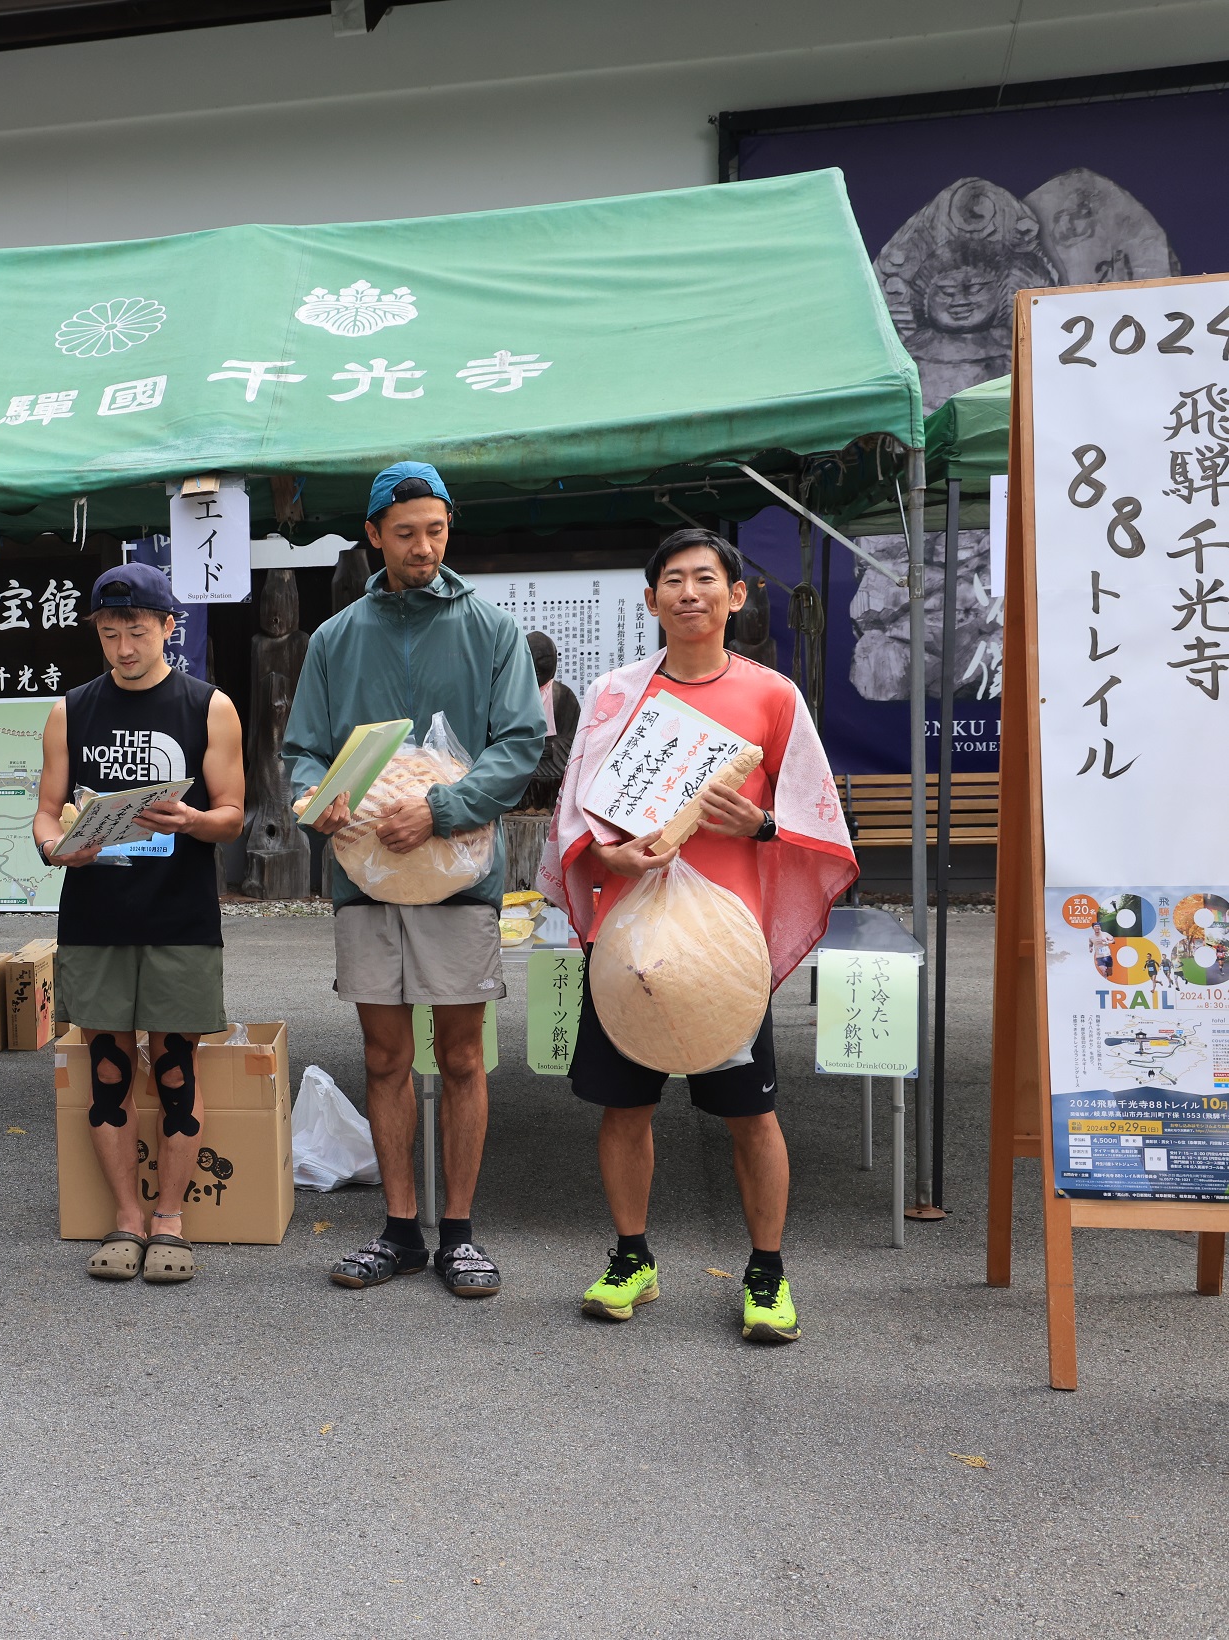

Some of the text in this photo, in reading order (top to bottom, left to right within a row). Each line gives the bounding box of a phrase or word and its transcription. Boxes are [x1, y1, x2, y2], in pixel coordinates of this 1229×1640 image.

[207, 349, 554, 402] 千光寺
[195, 500, 223, 592] エイド
[1162, 382, 1229, 702] 飛騨千光寺
[1068, 443, 1142, 780] 88トレイル
[82, 746, 149, 763] NORTH
[112, 729, 150, 747] THE
[99, 763, 149, 781] FACE
[1158, 896, 1170, 948] 飛騨千光寺
[551, 957, 569, 1061] スポーツ飲料
[843, 956, 863, 1059] スポーツ飲料
[871, 956, 890, 1040] やや冷たい
[1095, 990, 1175, 1010] TRAIL
[1204, 1001, 1224, 1009] 8:30
[537, 1062, 564, 1070] Isotonic
[825, 1060, 908, 1071] Isotonic Drink(COLD)
[141, 1178, 227, 1206] したけ
